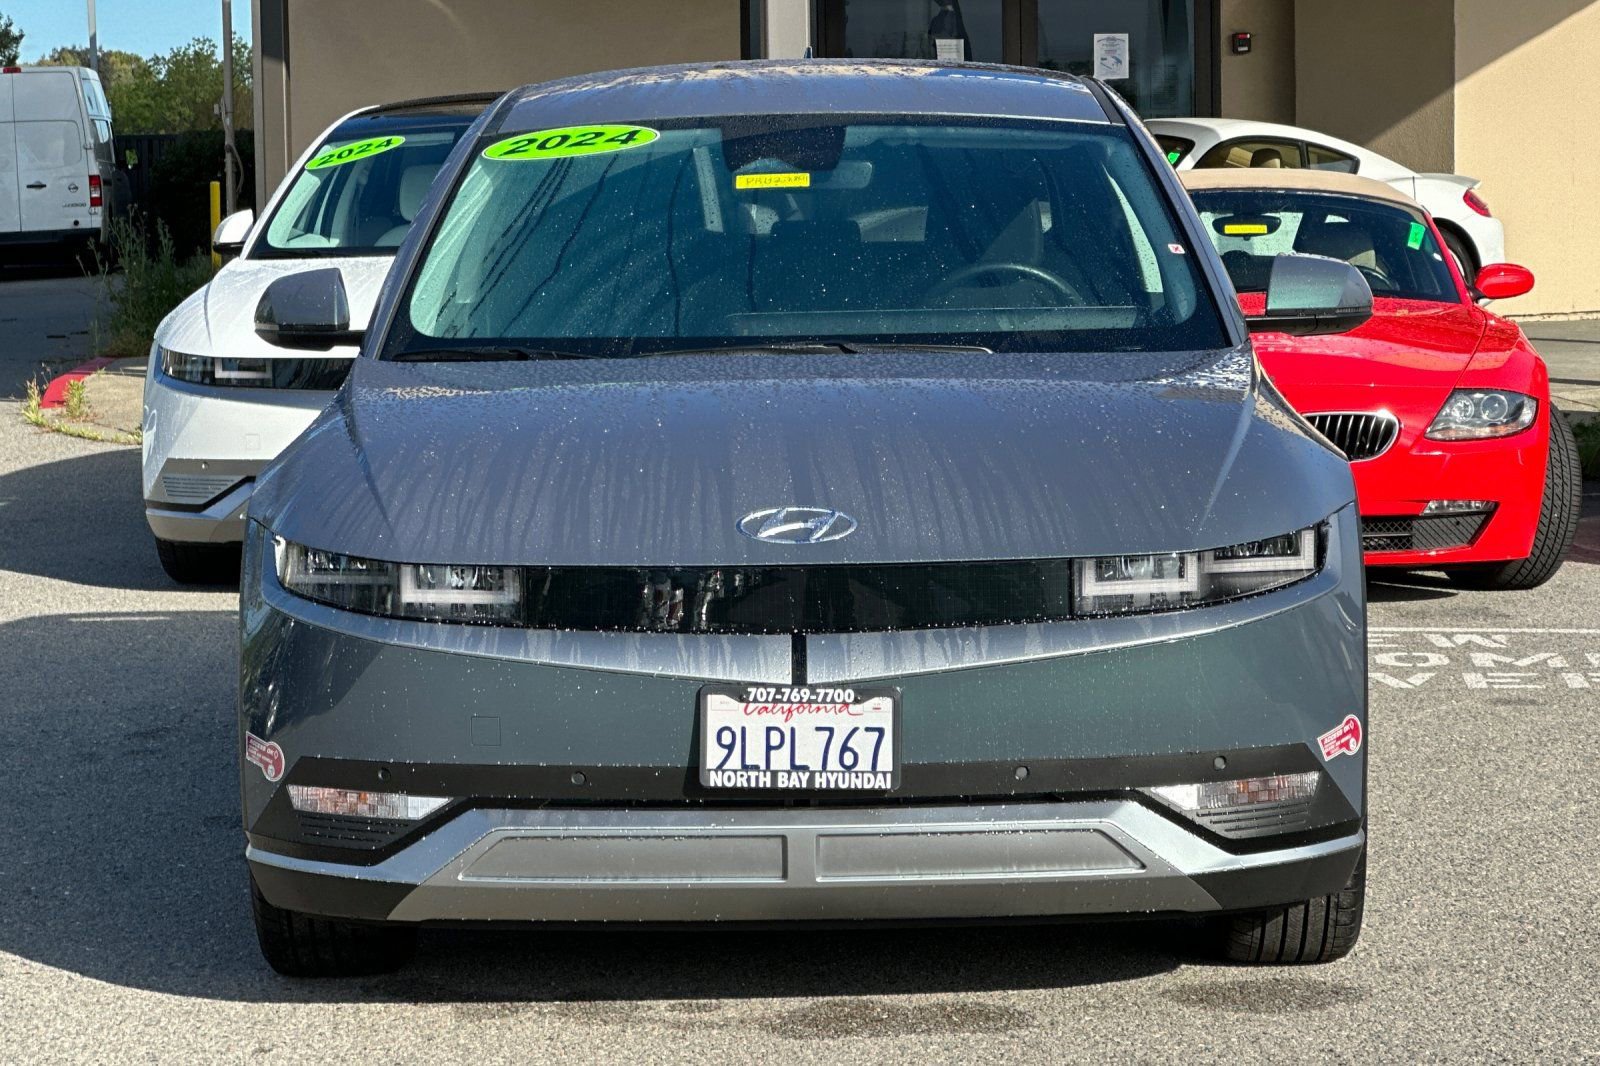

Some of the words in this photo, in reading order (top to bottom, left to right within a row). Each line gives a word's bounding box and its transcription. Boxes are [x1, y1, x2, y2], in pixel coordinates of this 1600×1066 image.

[318, 138, 395, 167] 2024
[504, 129, 641, 156] 2024
[747, 687, 855, 703] 707-769-7700
[743, 703, 863, 723] California
[715, 725, 886, 771] 9LPL767
[709, 771, 771, 788] NORTH
[777, 772, 810, 788] BAY
[814, 772, 892, 789] HYUNDAI
